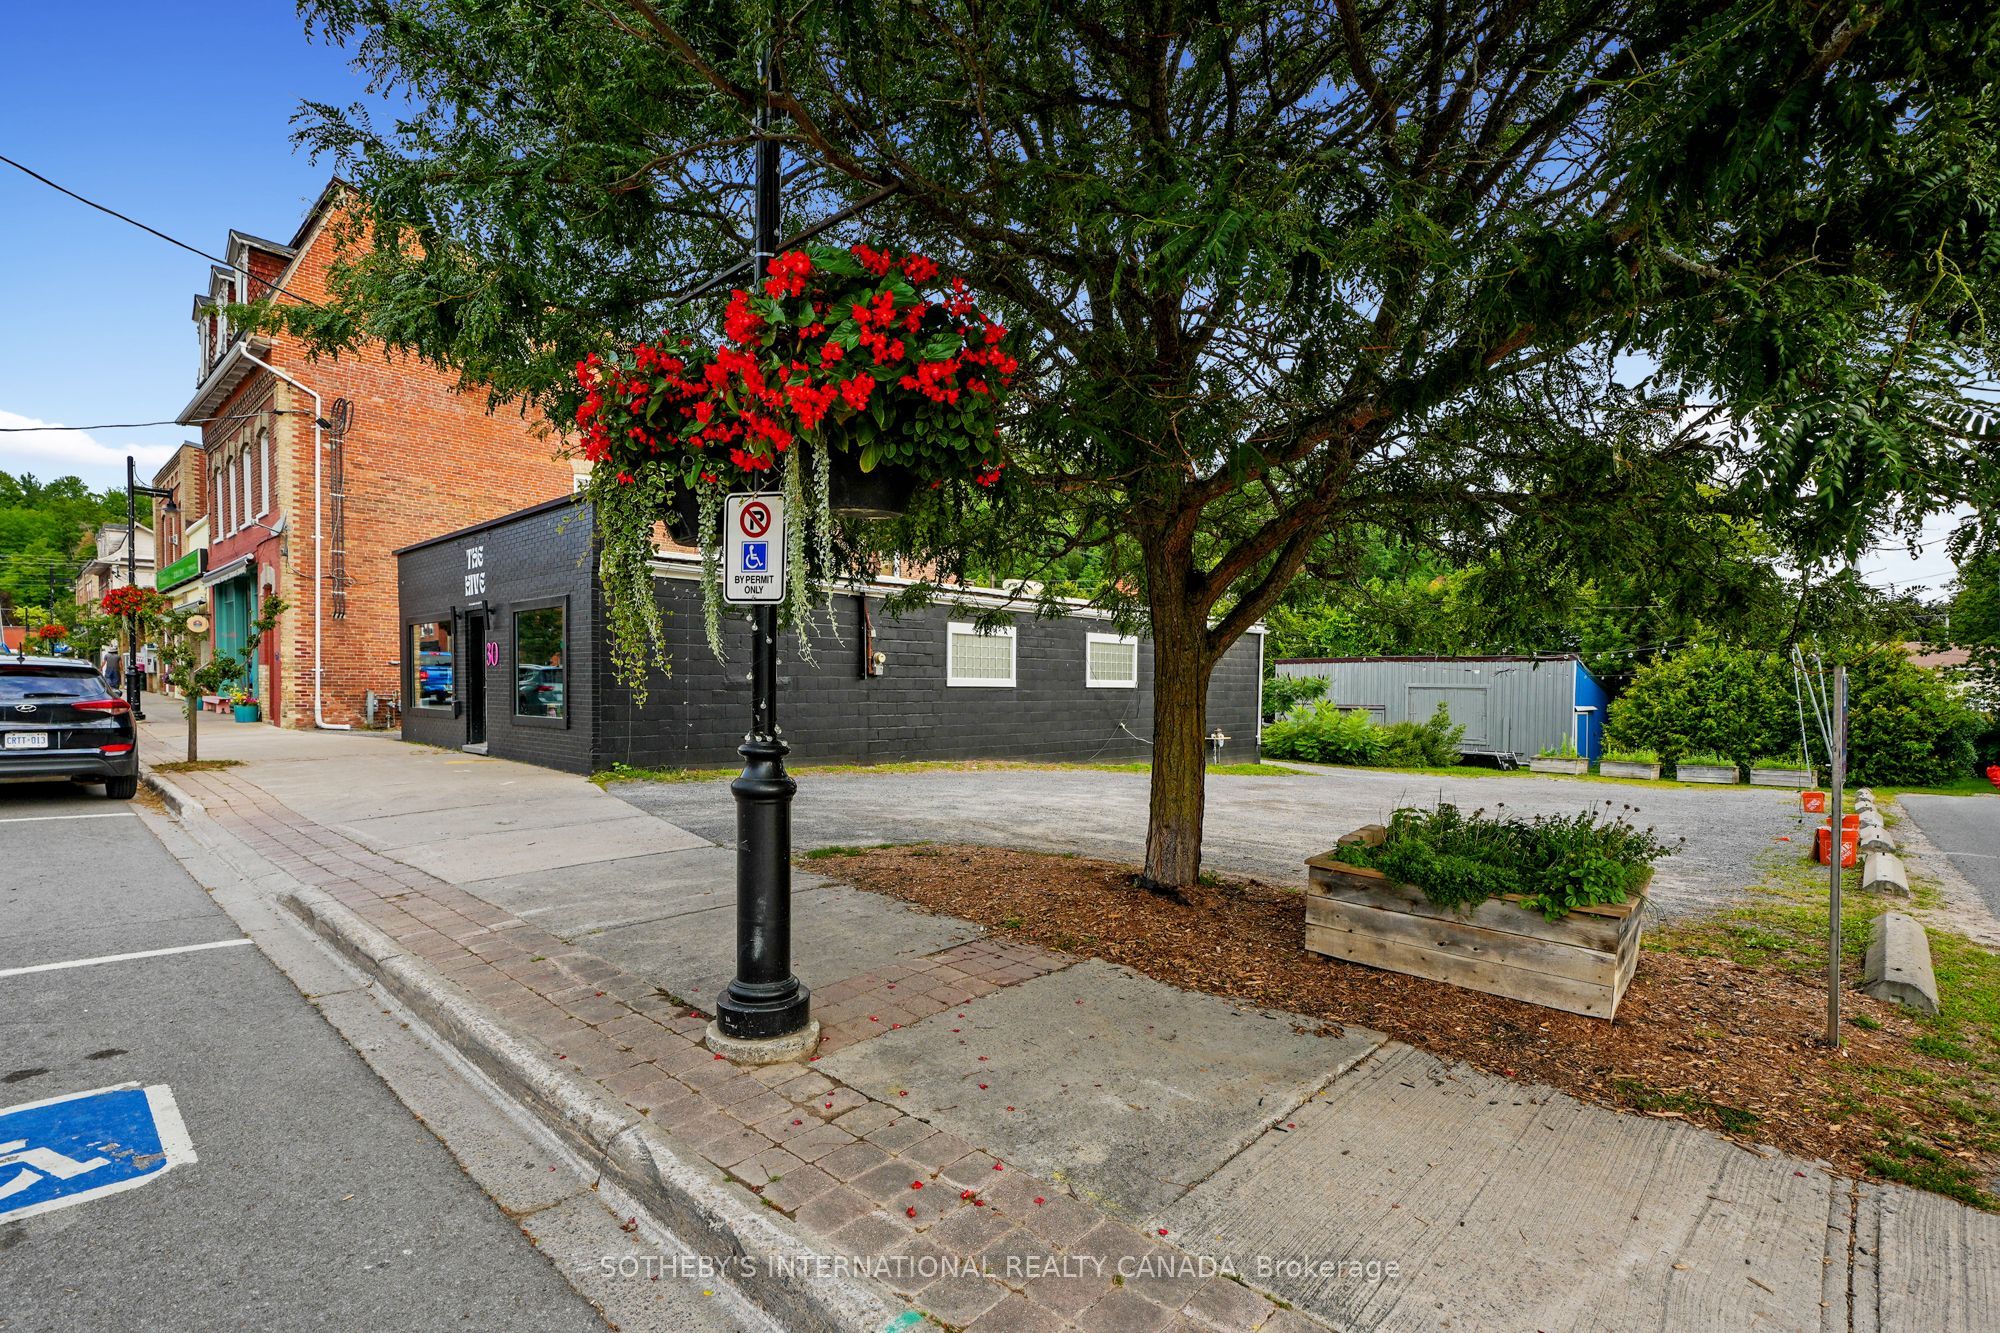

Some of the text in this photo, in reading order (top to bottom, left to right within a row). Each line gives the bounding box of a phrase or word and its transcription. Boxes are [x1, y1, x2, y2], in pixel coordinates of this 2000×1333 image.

[466, 545, 484, 569] THE
[464, 572, 486, 596] HIVE
[734, 575, 774, 584] BY PERMIT
[744, 585, 764, 594] ONLY
[486, 641, 499, 667] 30
